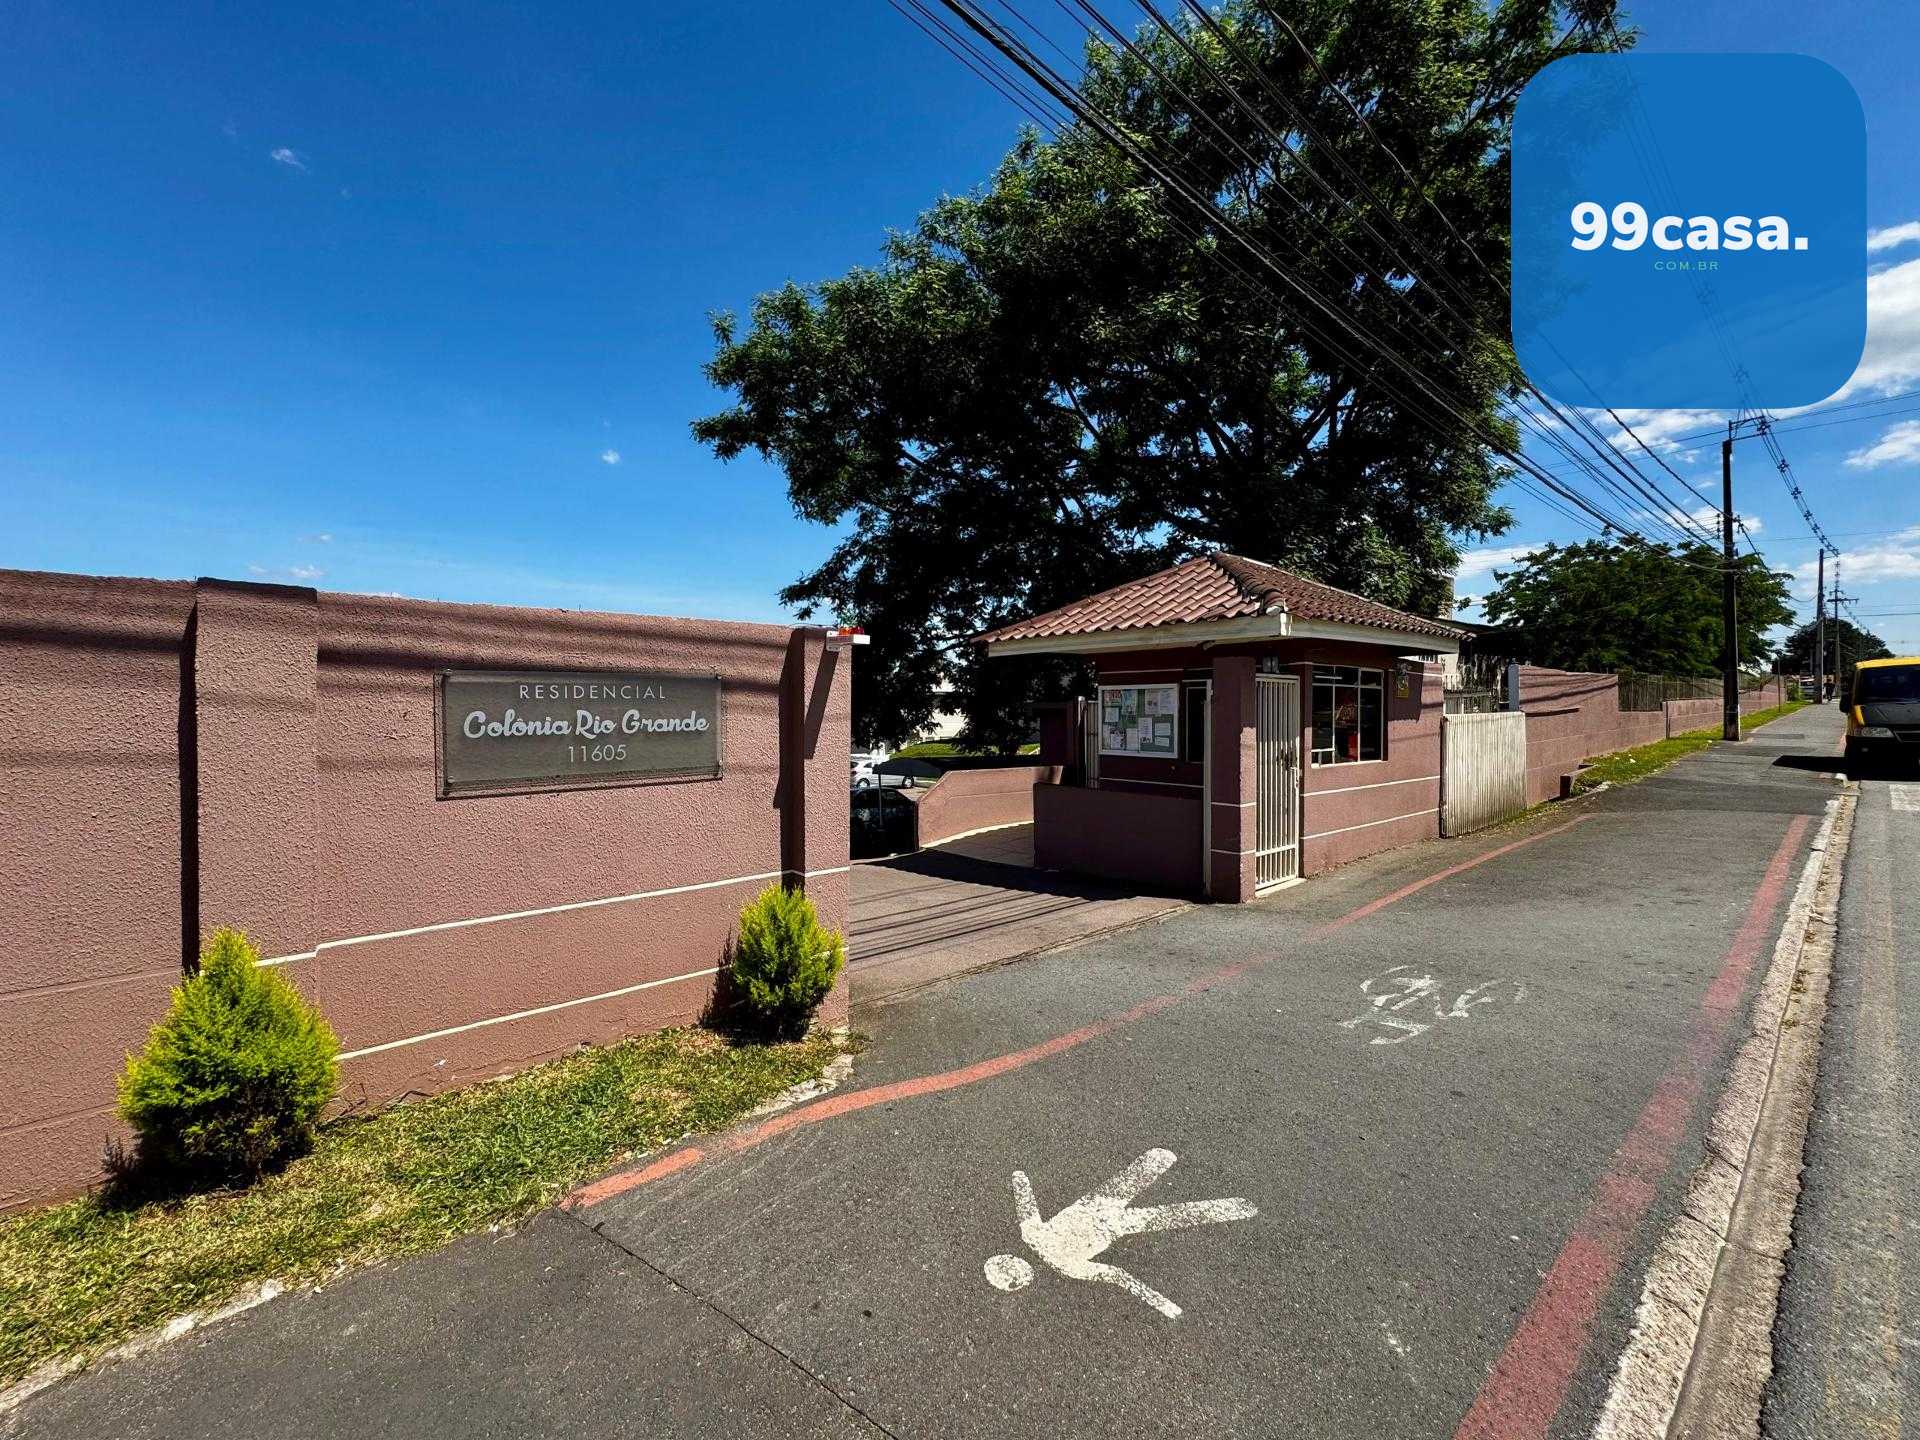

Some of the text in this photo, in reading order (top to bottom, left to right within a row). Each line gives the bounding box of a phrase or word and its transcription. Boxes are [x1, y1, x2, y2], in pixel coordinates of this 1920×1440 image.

[520, 684, 666, 699] RESIDENCIAL
[463, 709, 709, 739] Colônia Rio Grande
[568, 744, 626, 762] 11605
